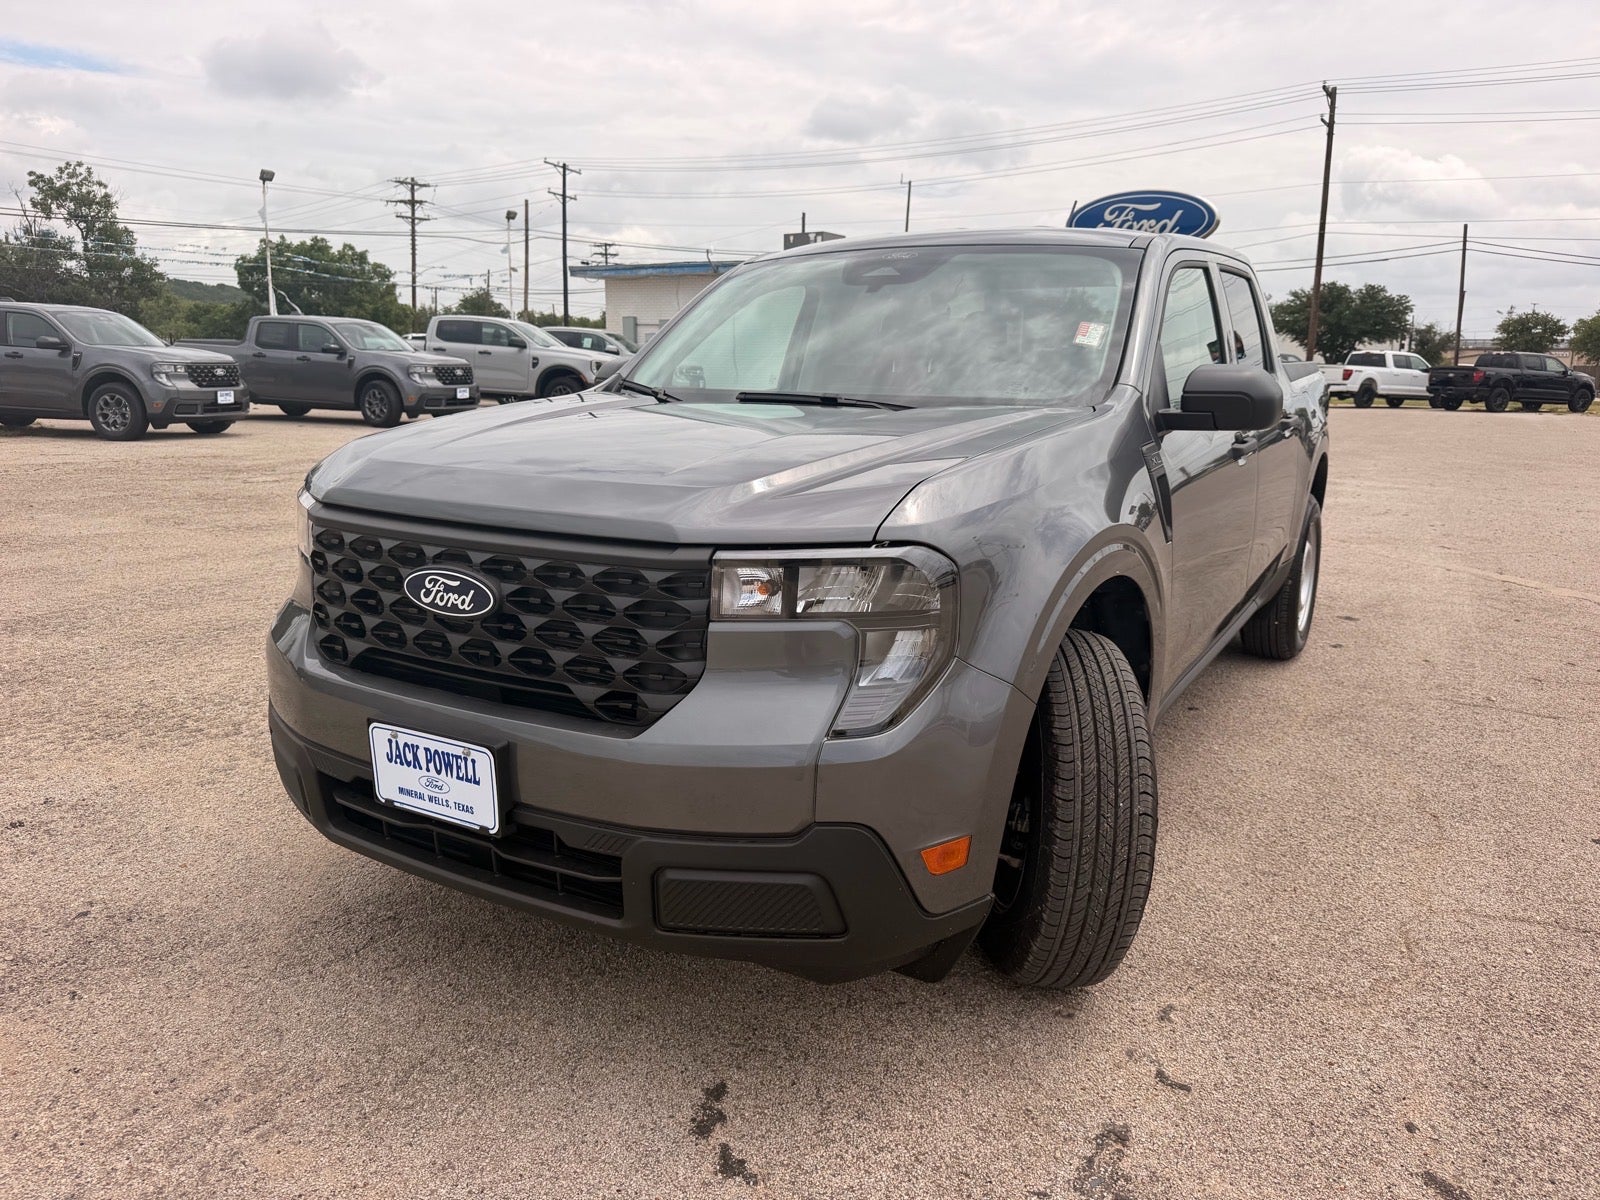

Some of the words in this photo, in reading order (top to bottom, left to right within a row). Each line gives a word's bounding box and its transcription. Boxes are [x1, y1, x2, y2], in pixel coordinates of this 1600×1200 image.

[1096, 203, 1184, 234] Ford
[420, 575, 475, 611] Ford
[386, 738, 423, 771] JACK
[423, 746, 481, 786] POWELL
[424, 777, 444, 792] Ford
[398, 786, 426, 802] MINERAL
[427, 794, 452, 810] WELLS,
[453, 801, 475, 815] TEXAS
